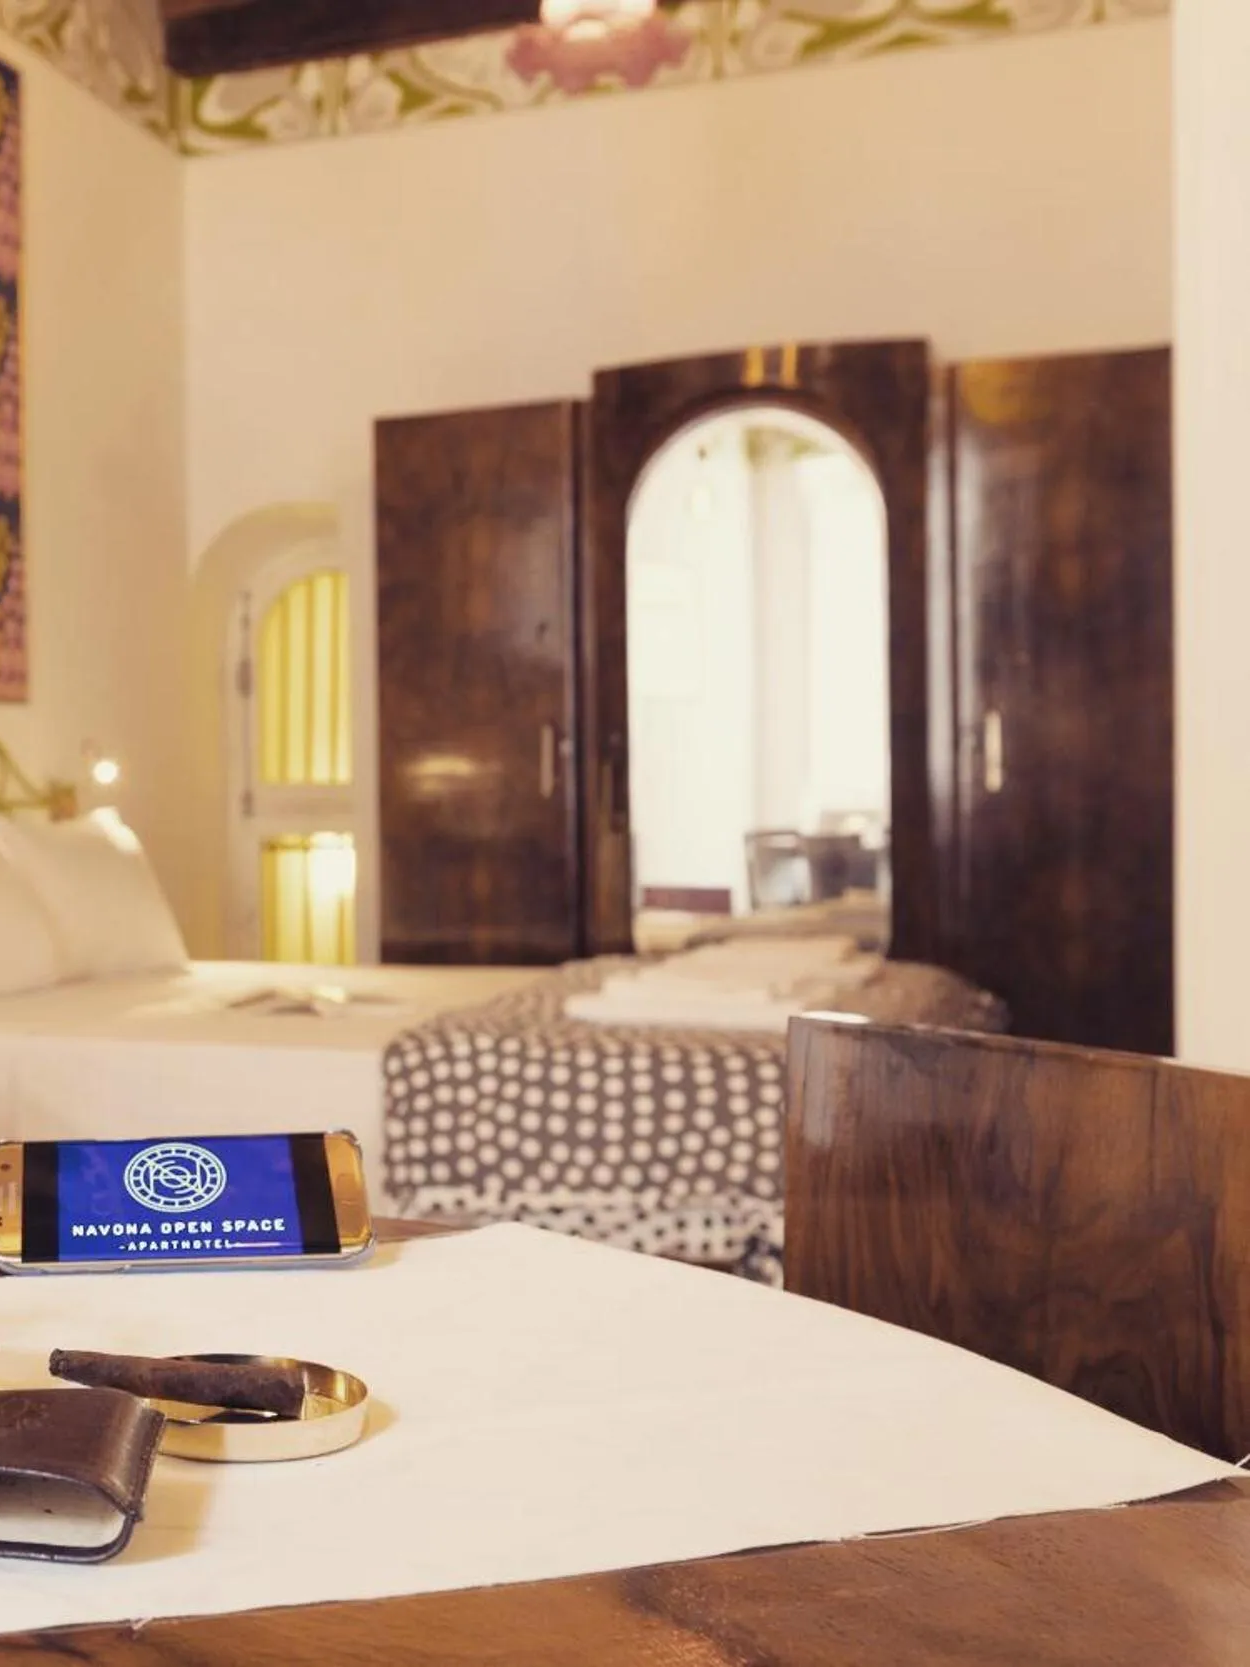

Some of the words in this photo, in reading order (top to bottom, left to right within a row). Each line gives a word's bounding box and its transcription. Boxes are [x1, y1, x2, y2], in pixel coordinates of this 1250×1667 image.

[71, 1222, 152, 1237] NAVONA
[160, 1220, 213, 1235] OPEN
[221, 1217, 286, 1233] SPACE
